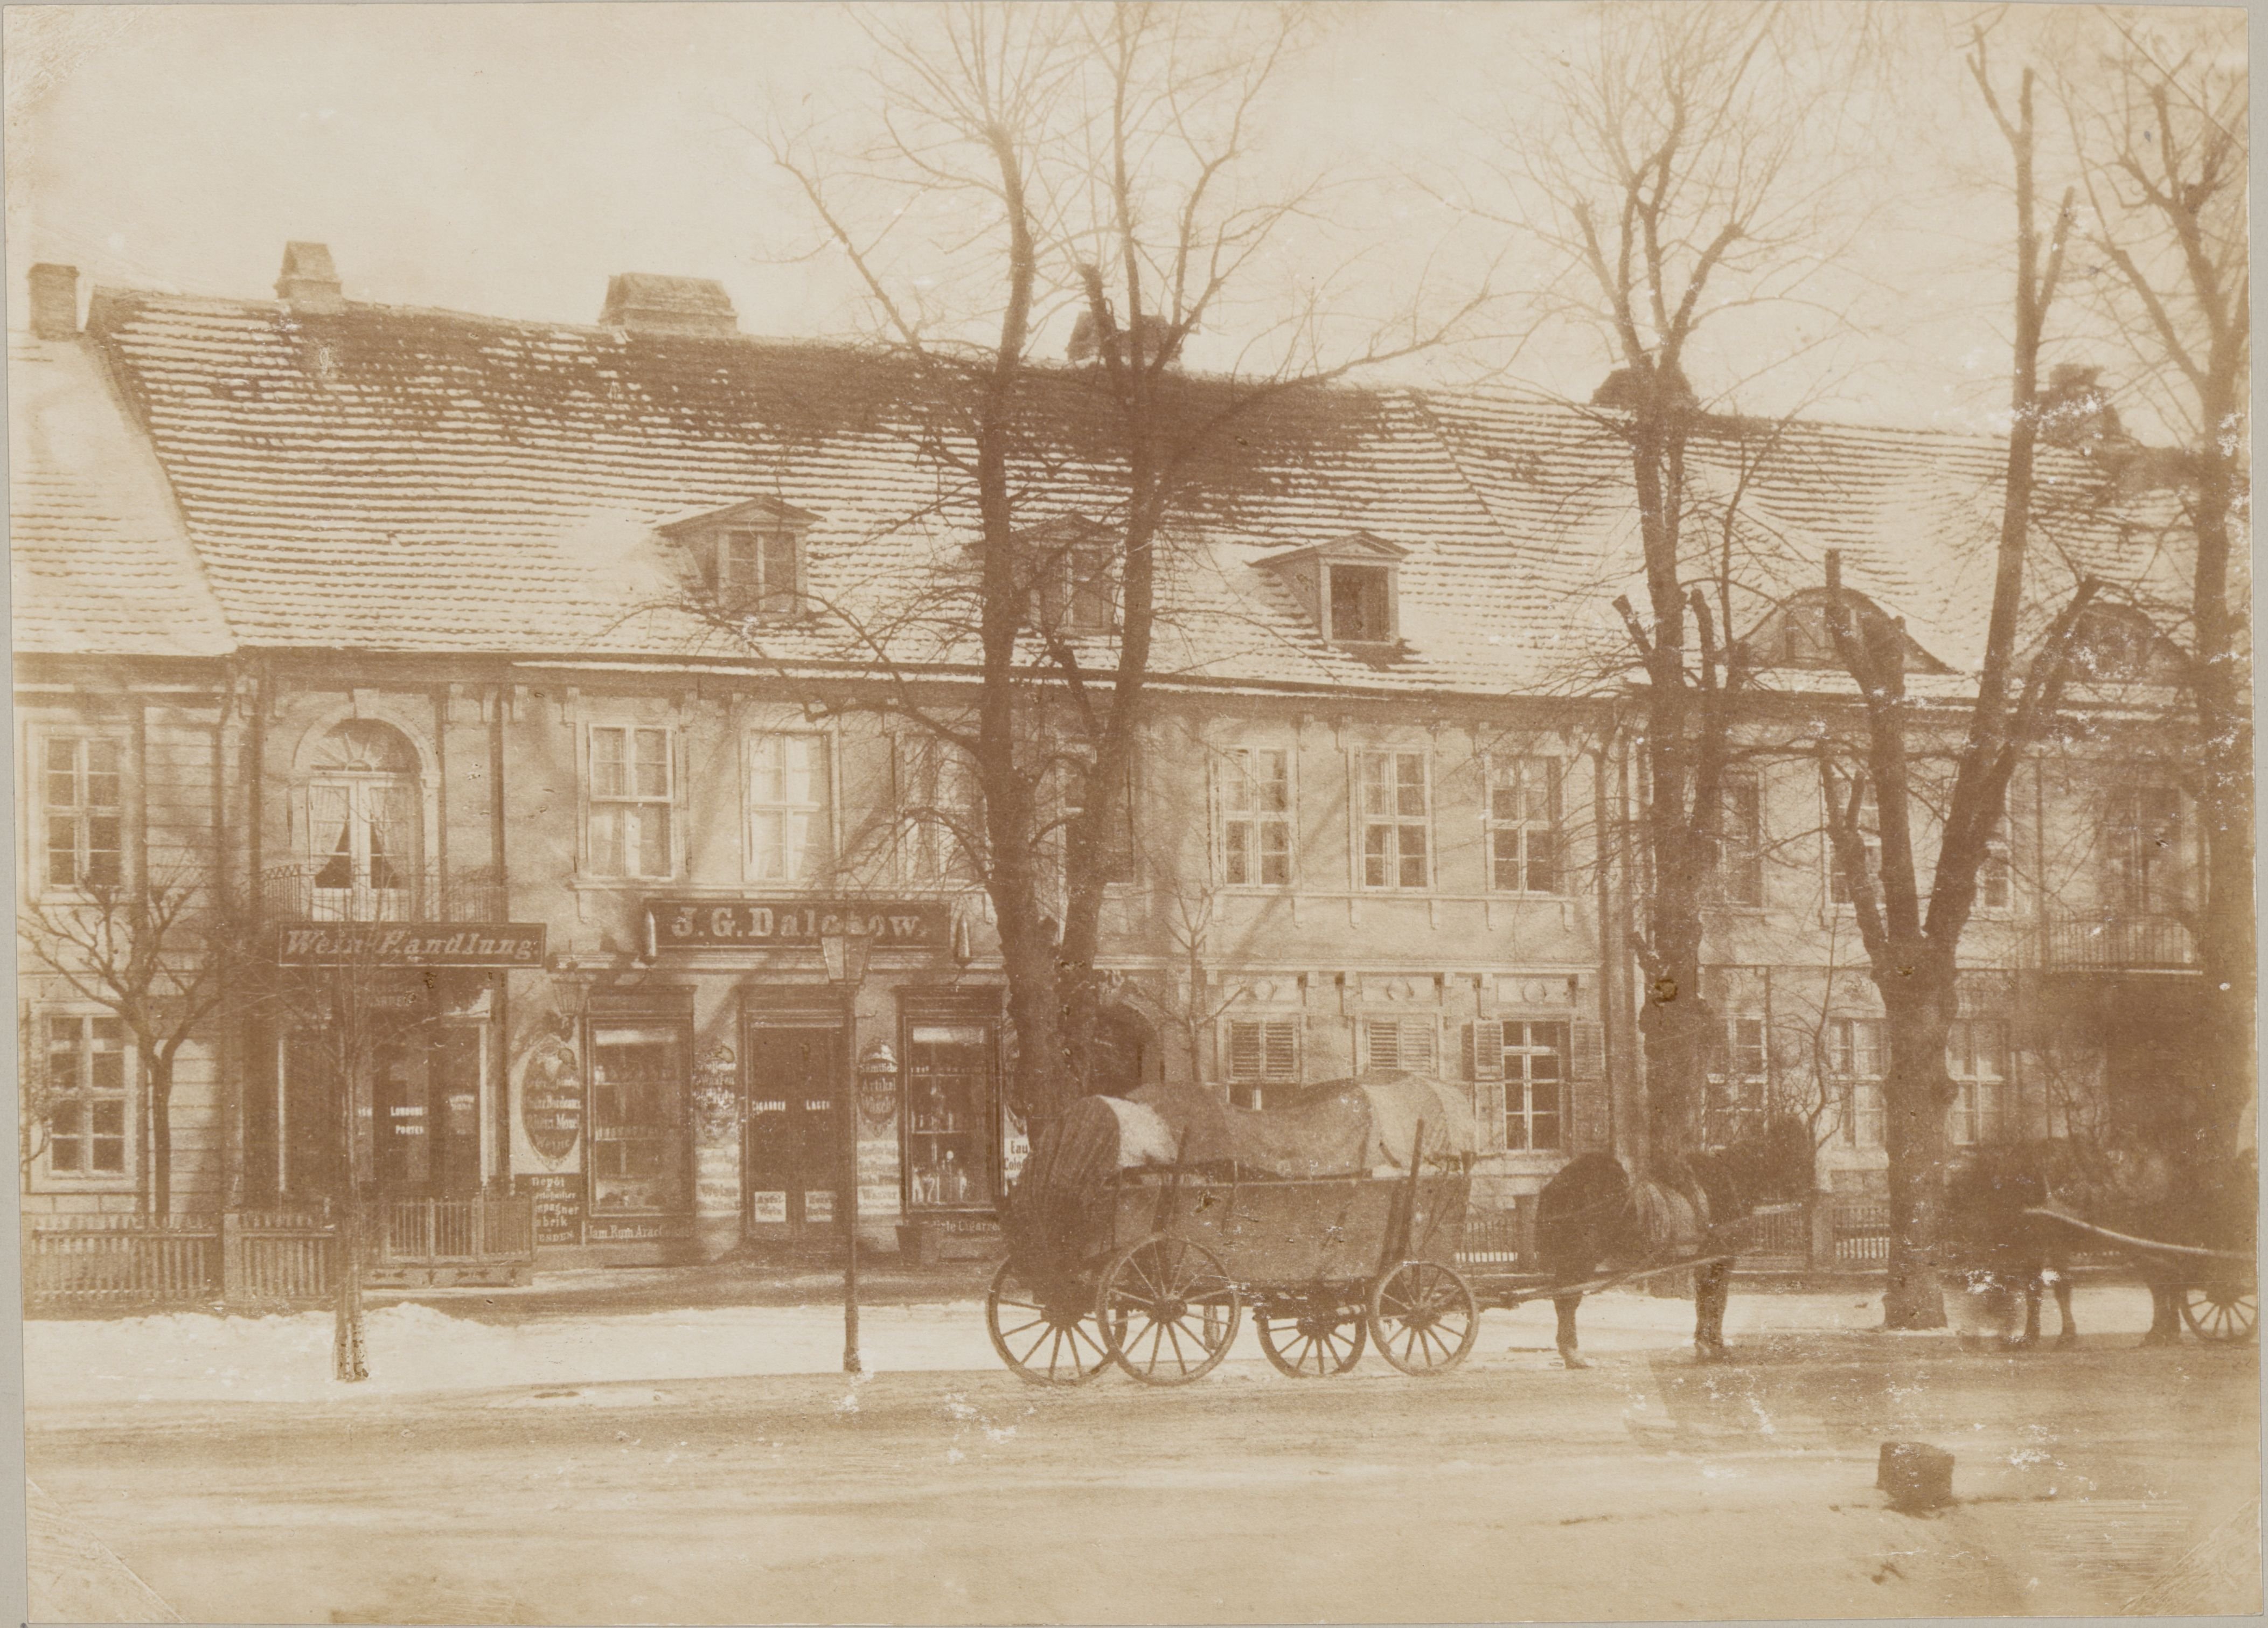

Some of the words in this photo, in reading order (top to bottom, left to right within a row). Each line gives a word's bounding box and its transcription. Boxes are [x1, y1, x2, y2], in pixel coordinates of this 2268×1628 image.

[1011, 1140, 1028, 1154] Eau
[1004, 1157, 1022, 1171] Colo
[536, 1203, 580, 1217] mpagner
[539, 1230, 574, 1242] ESDEN
